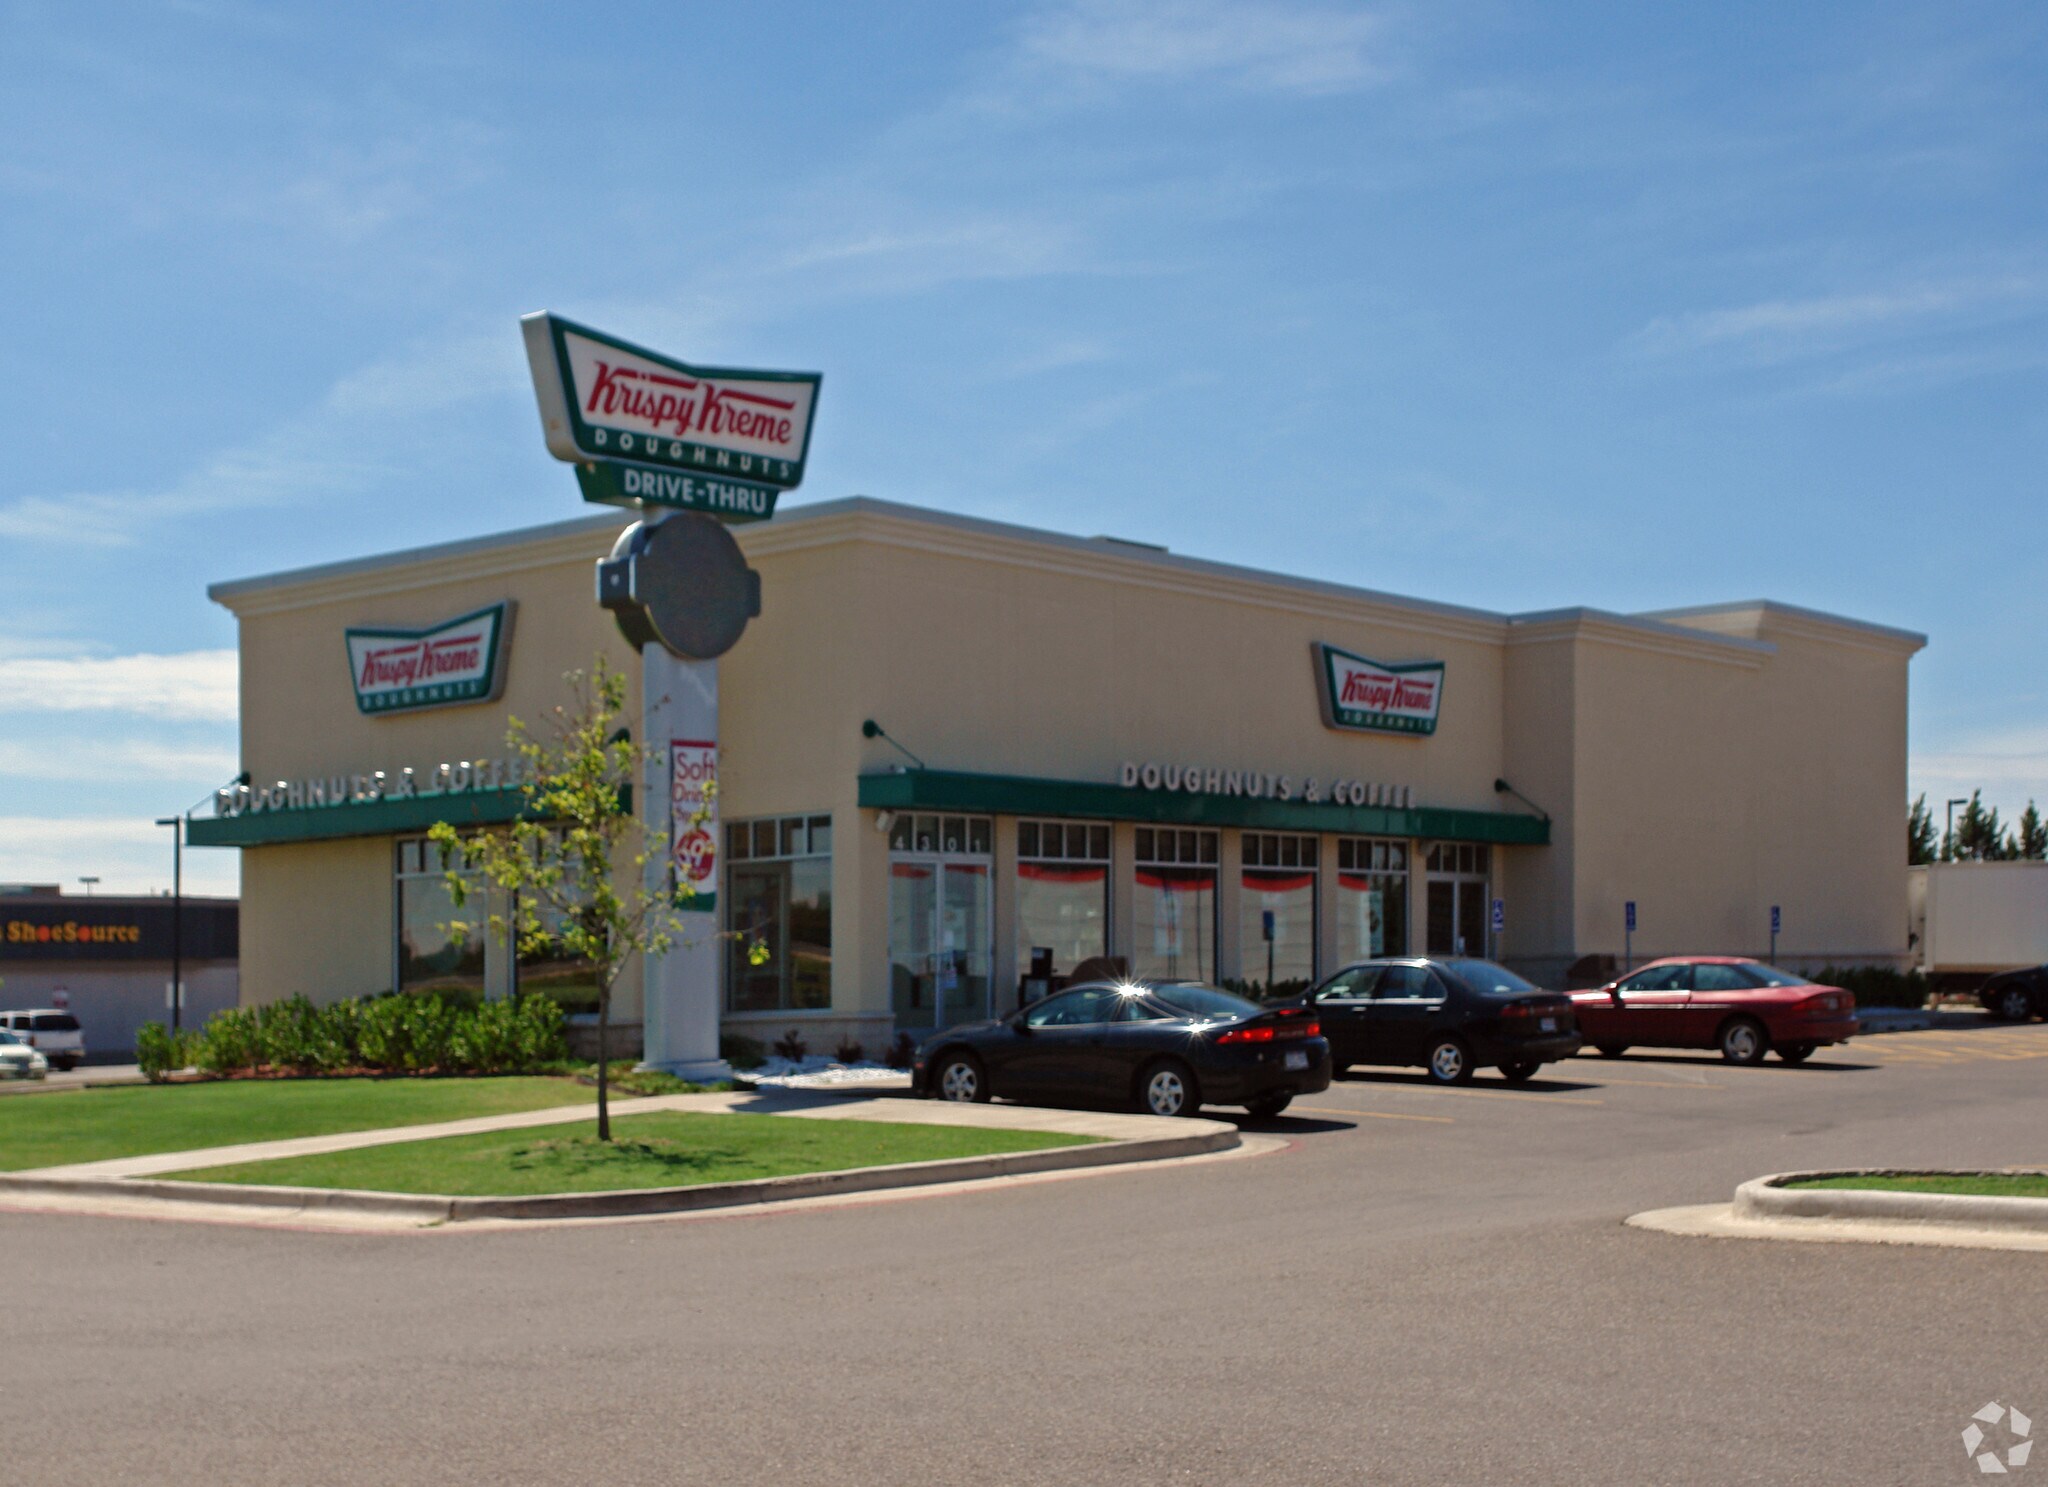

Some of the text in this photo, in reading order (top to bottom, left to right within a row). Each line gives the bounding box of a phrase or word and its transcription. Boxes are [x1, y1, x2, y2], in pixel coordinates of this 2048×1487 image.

[586, 361, 795, 444] Krispy Kreme
[595, 428, 790, 479] DOUGHNUTS
[624, 468, 767, 512] DRIVE-THRU
[360, 634, 482, 687] Krispy Kreme
[1341, 670, 1434, 711] Krispy Kreme
[215, 771, 384, 817] DOUGHNUTS
[430, 758, 541, 793] COFFE
[676, 752, 715, 780] Soft
[1122, 761, 1291, 800] DOUGHNUTS
[1305, 778, 1320, 803] &
[7, 920, 139, 942] ShoeSource
